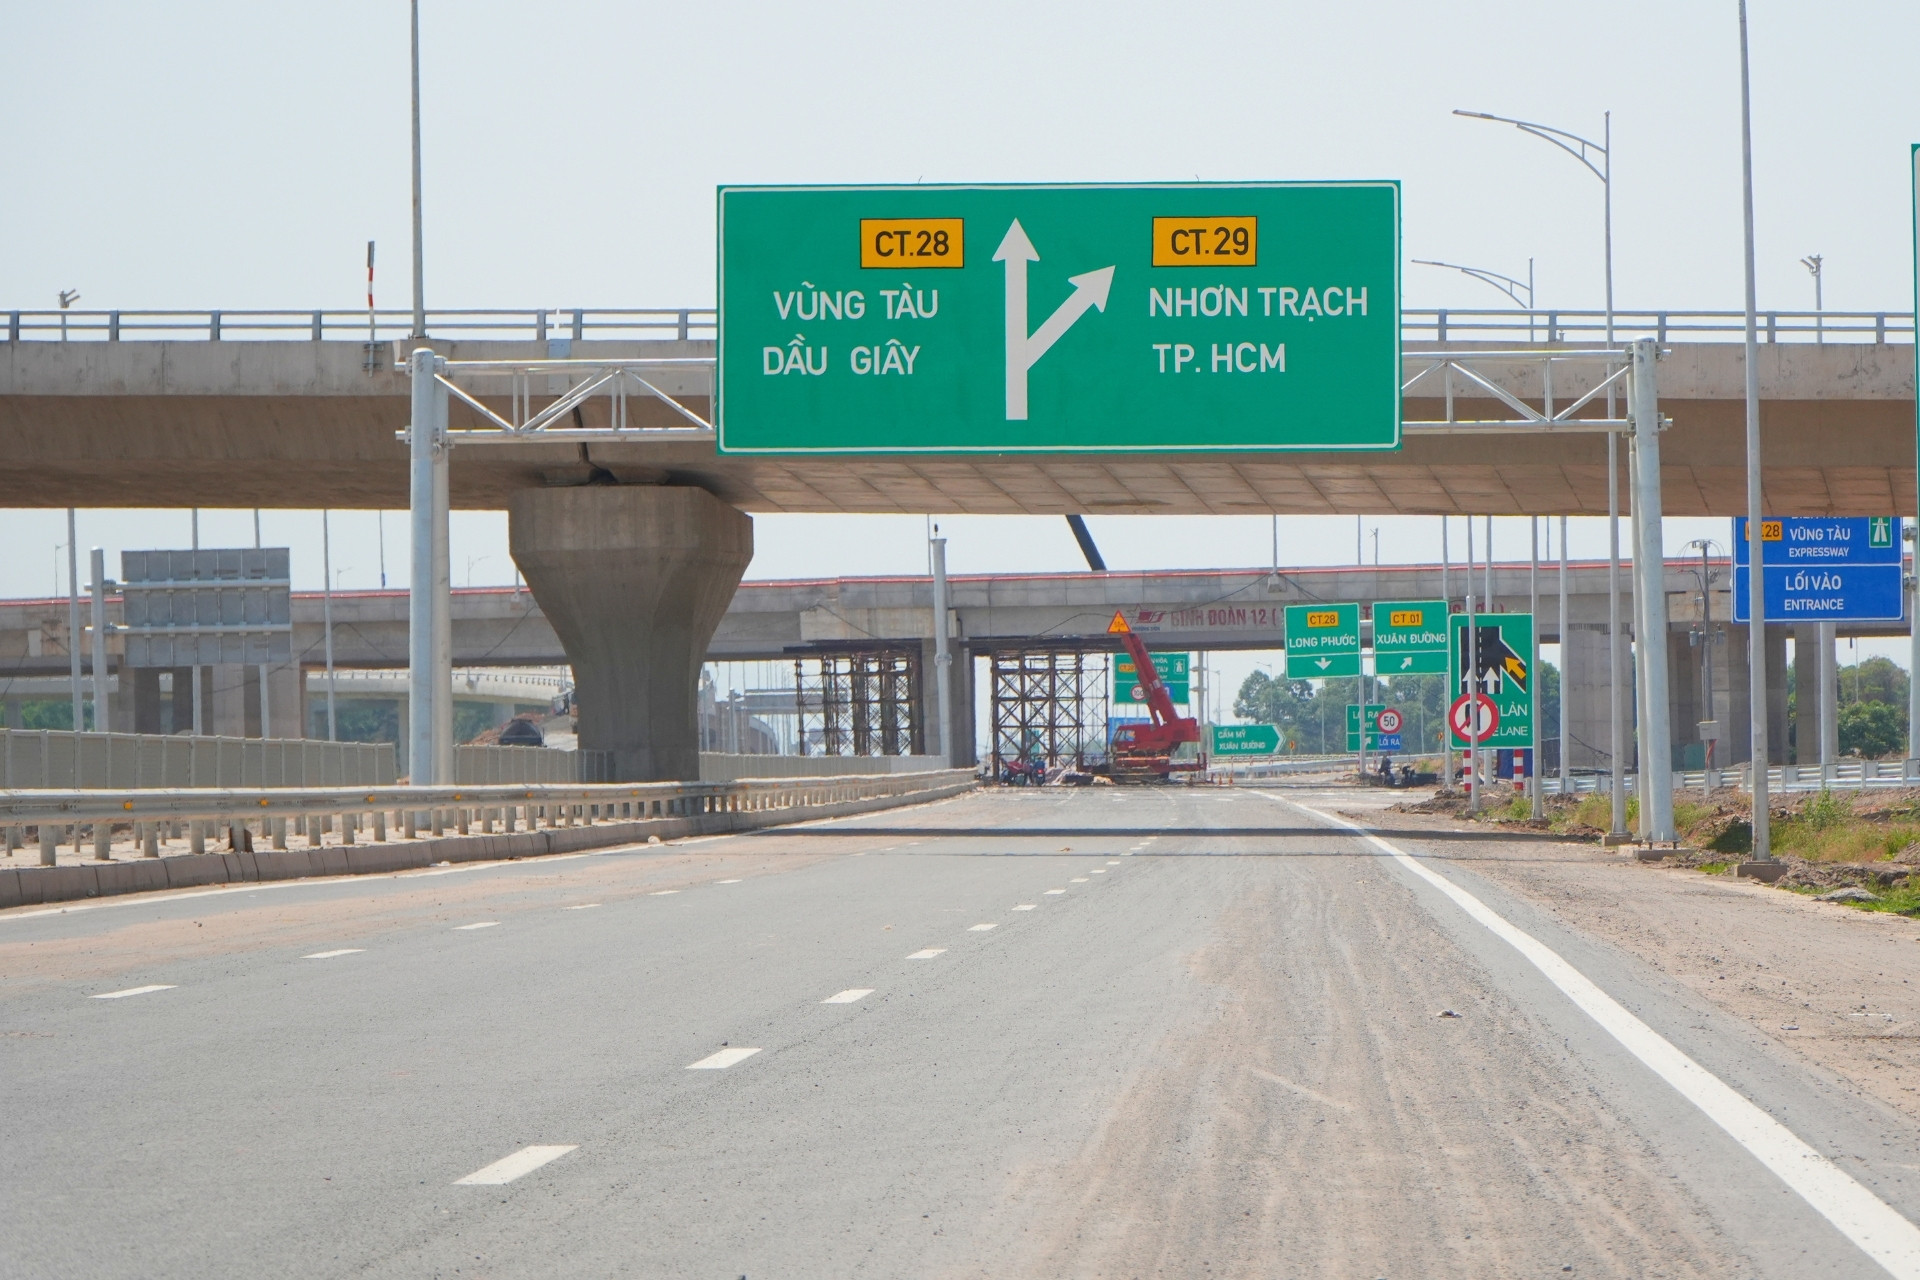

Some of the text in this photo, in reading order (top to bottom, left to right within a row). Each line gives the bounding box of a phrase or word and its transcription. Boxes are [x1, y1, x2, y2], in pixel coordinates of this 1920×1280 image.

[875, 230, 949, 257] CT.28
[1170, 227, 1249, 256] CT.29
[774, 282, 939, 320] VŨNG TÀU
[1149, 285, 1368, 322] NHƠN TRẠCH
[762, 334, 920, 375] DẦU GIÂY
[1153, 343, 1286, 373] TP. HCM
[1790, 525, 1851, 541] VŨNG TÀU
[1789, 547, 1849, 557] EXPRESSWAY
[1785, 571, 1842, 591] LỐI VÀO
[1784, 599, 1844, 611] ENTRANCE
[1208, 606, 1246, 626] ĐOÀN
[1251, 608, 1266, 625] 12
[1310, 614, 1336, 625] CT.28
[1289, 633, 1357, 648] LONG PHƯỚC
[1500, 701, 1528, 717] LÀN
[1384, 716, 1395, 727] 50
[1500, 726, 1528, 737] LANE
